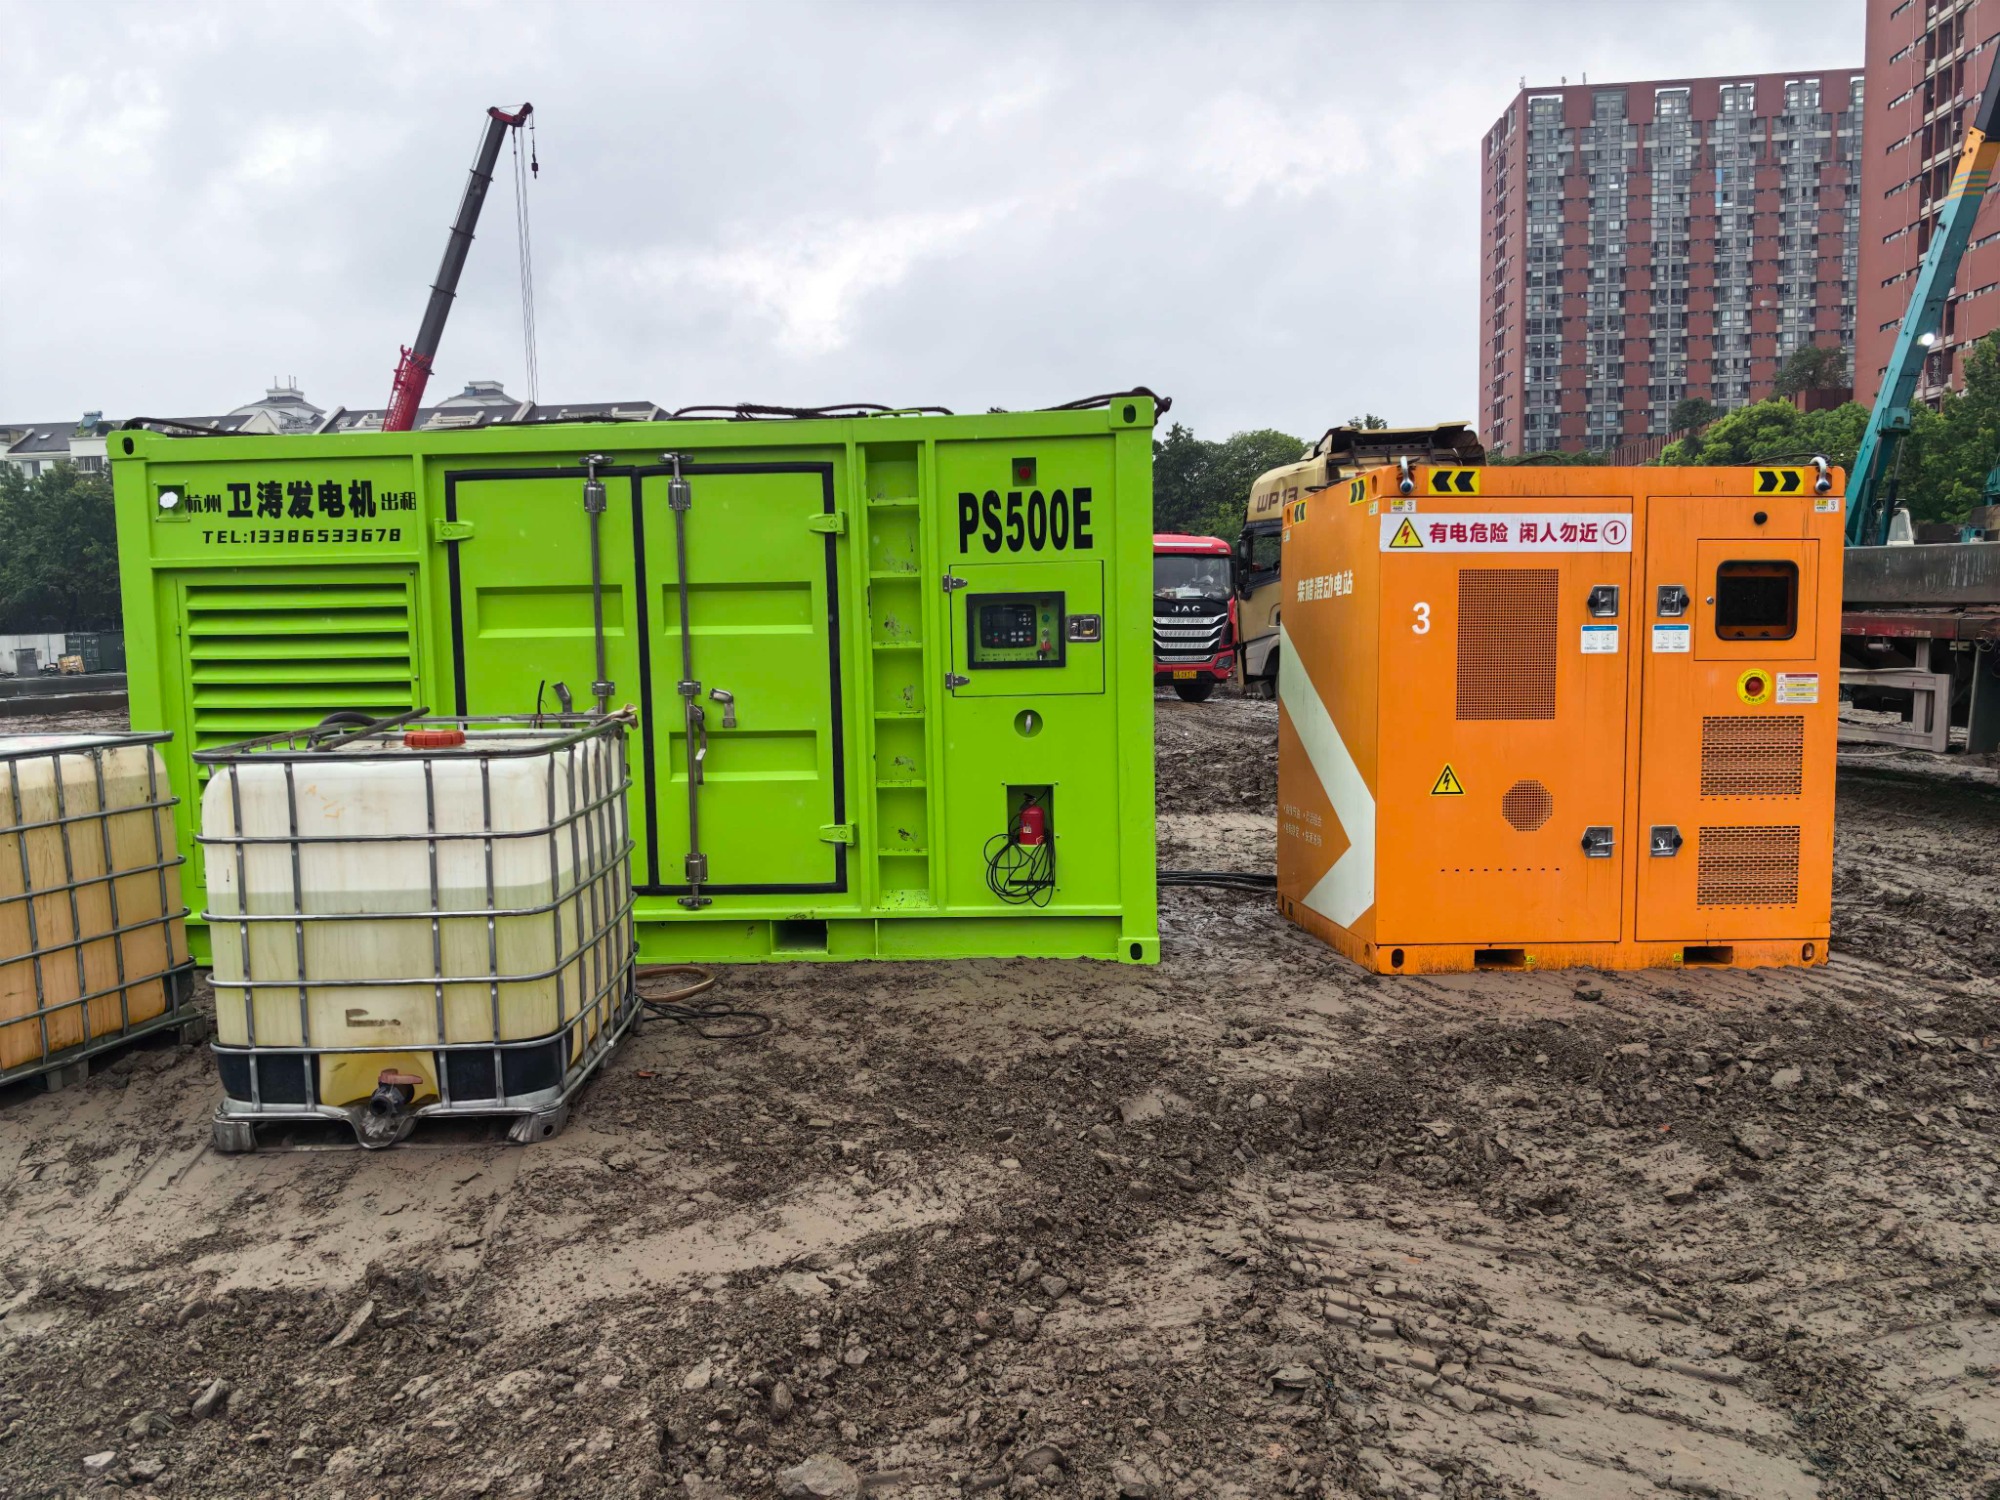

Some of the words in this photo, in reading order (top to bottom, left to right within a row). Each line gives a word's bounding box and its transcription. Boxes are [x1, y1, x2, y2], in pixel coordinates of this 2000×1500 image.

[958, 487, 1094, 553] PS500E
[202, 528, 401, 544] TEL:13386533678
[1429, 522, 1508, 543] 有电危险
[1519, 522, 1598, 543] 闲人勿近
[1171, 605, 1201, 613] JAC
[1411, 602, 1431, 634] 3
